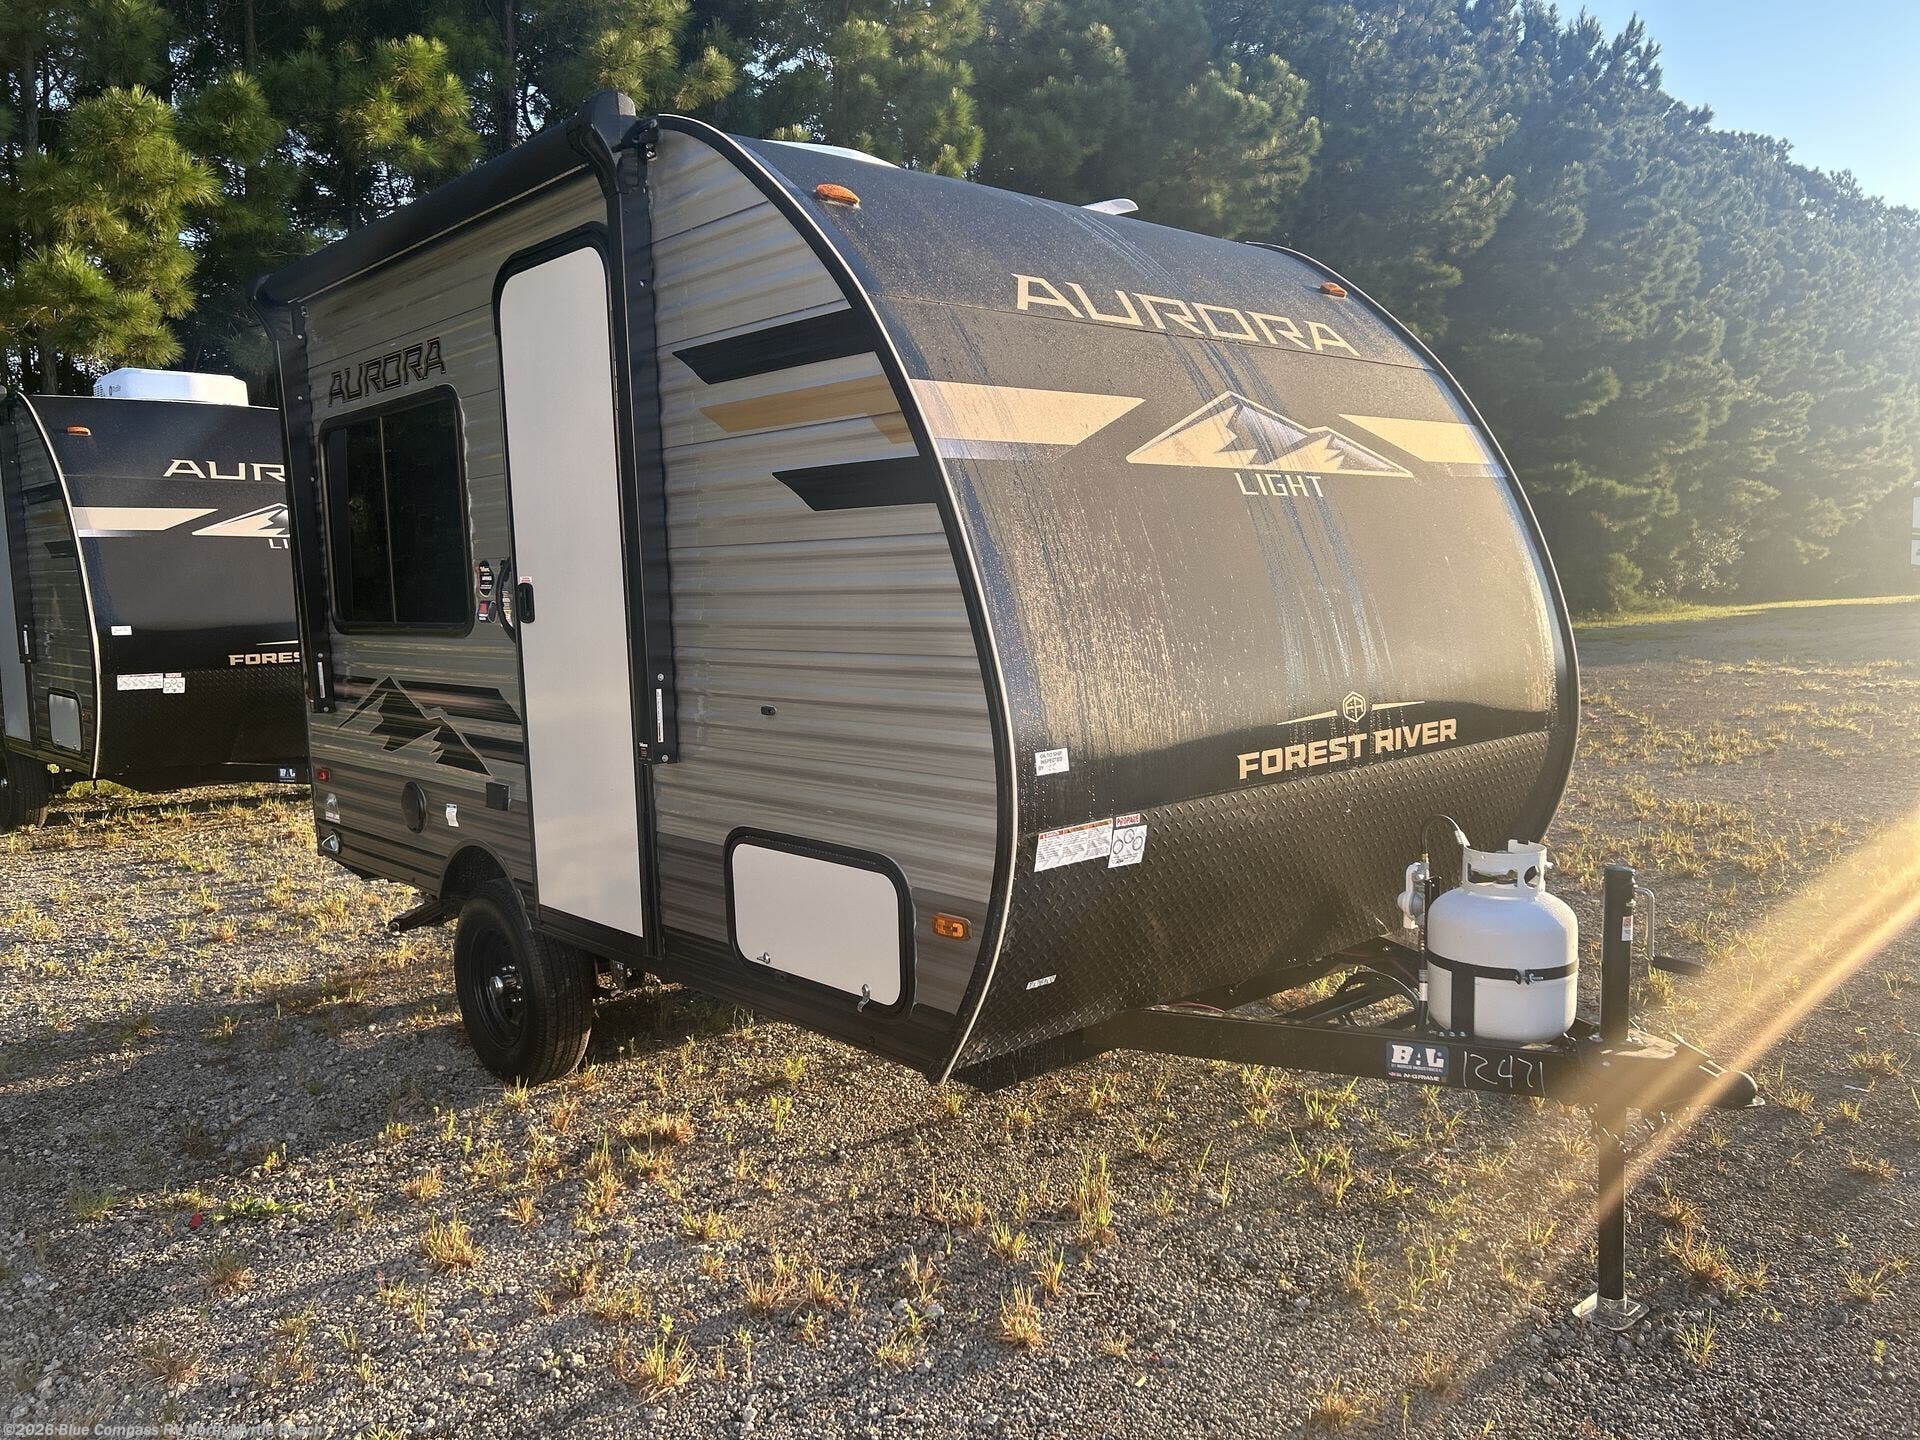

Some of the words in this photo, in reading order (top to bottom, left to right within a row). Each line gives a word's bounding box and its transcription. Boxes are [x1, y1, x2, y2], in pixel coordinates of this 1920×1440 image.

[1011, 273, 1361, 357] AURORA
[328, 337, 446, 408] AURORA
[1233, 472, 1325, 498] LIGHT
[1237, 733, 1367, 780] FOREST
[1373, 718, 1457, 754] RIVER
